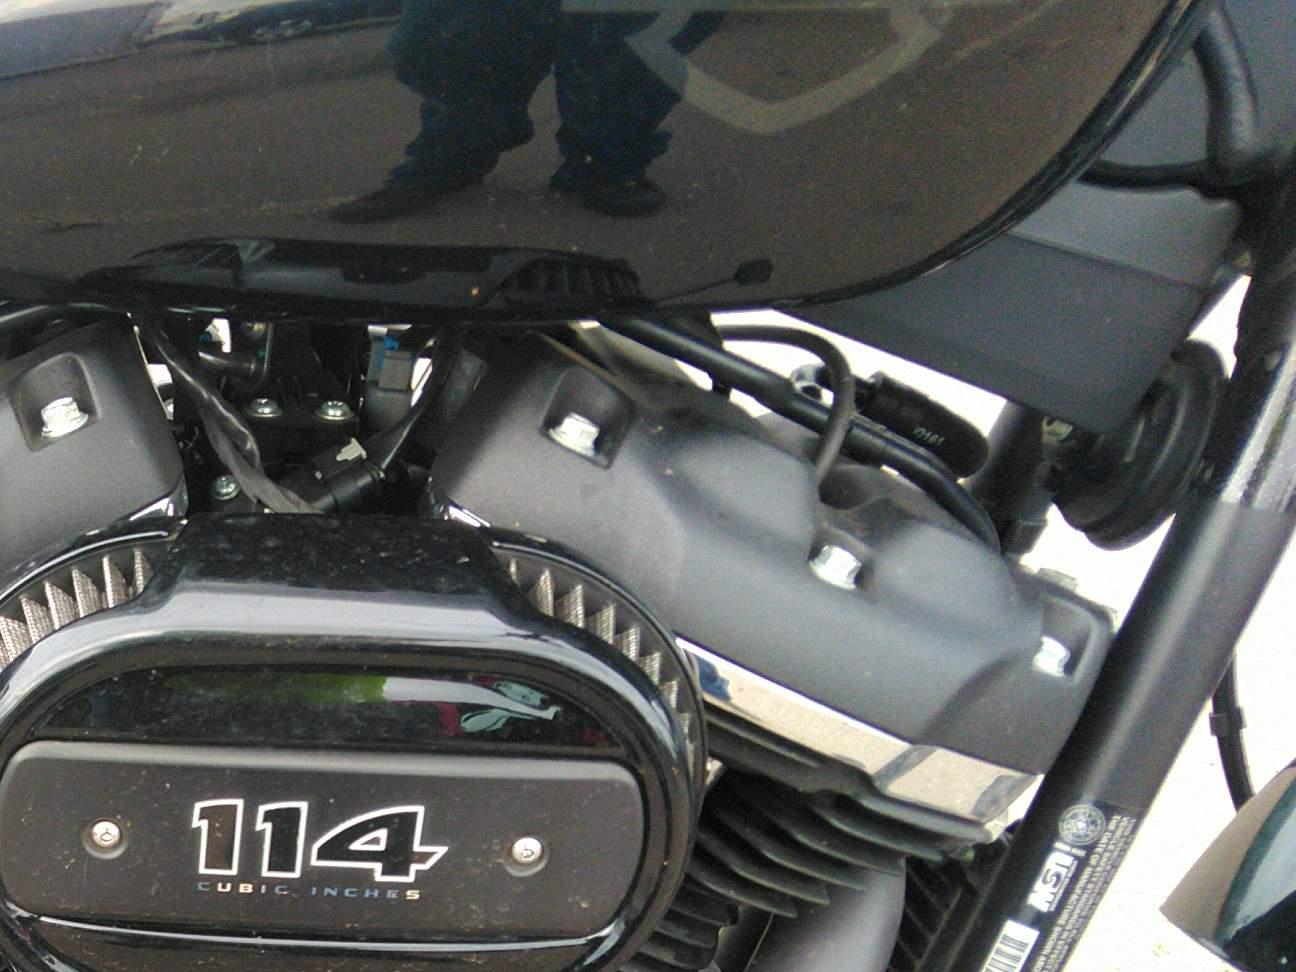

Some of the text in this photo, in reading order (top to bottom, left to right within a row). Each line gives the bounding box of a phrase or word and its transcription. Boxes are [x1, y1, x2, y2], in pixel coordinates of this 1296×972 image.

[192, 799, 449, 882] 114
[197, 881, 421, 901] CUBIC INCHES
